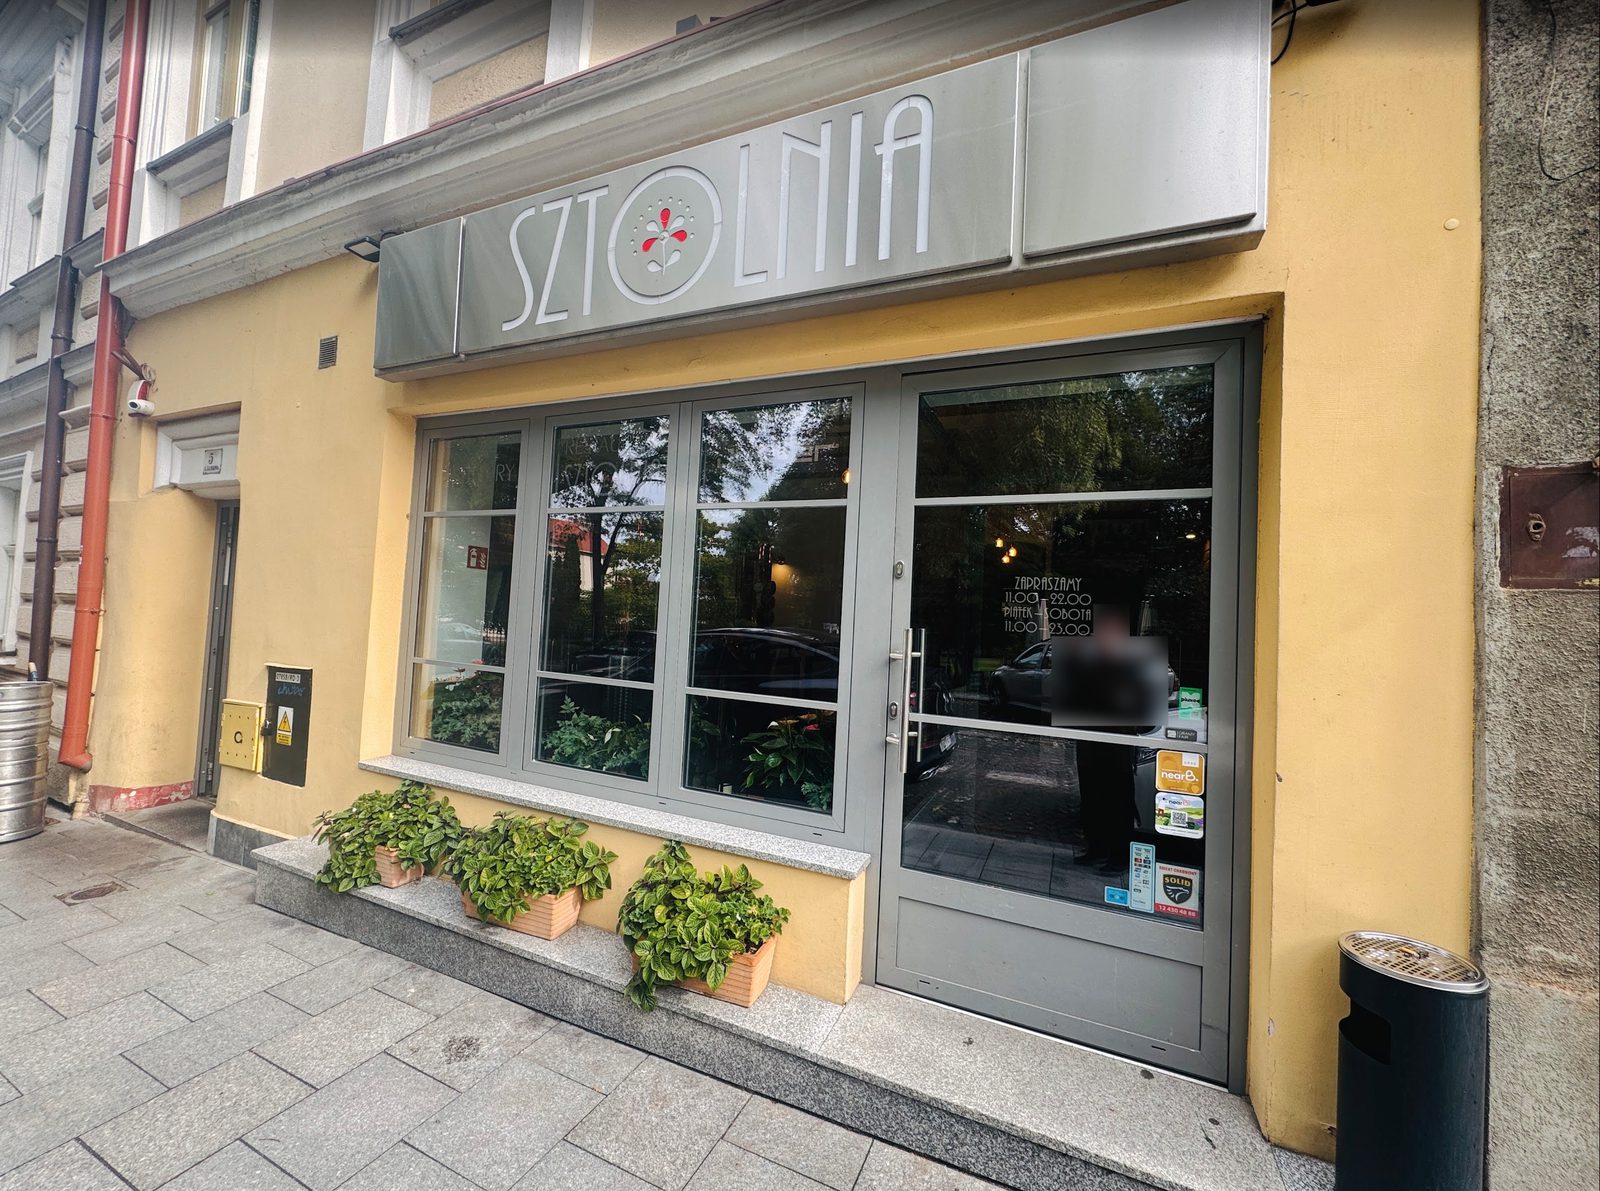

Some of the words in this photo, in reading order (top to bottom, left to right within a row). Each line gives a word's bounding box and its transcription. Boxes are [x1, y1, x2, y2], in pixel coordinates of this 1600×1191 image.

[502, 94, 934, 331] SZTOLNIA
[1014, 576, 1082, 591] ZAPRASZAMY
[1005, 591, 1038, 604] 11.00
[1050, 592, 1092, 606] 22.00
[1003, 606, 1033, 620] PIĄTEK
[1004, 620, 1038, 633] 11.00
[1049, 622, 1090, 636] 23.00
[1164, 876, 1191, 887] SOLID
